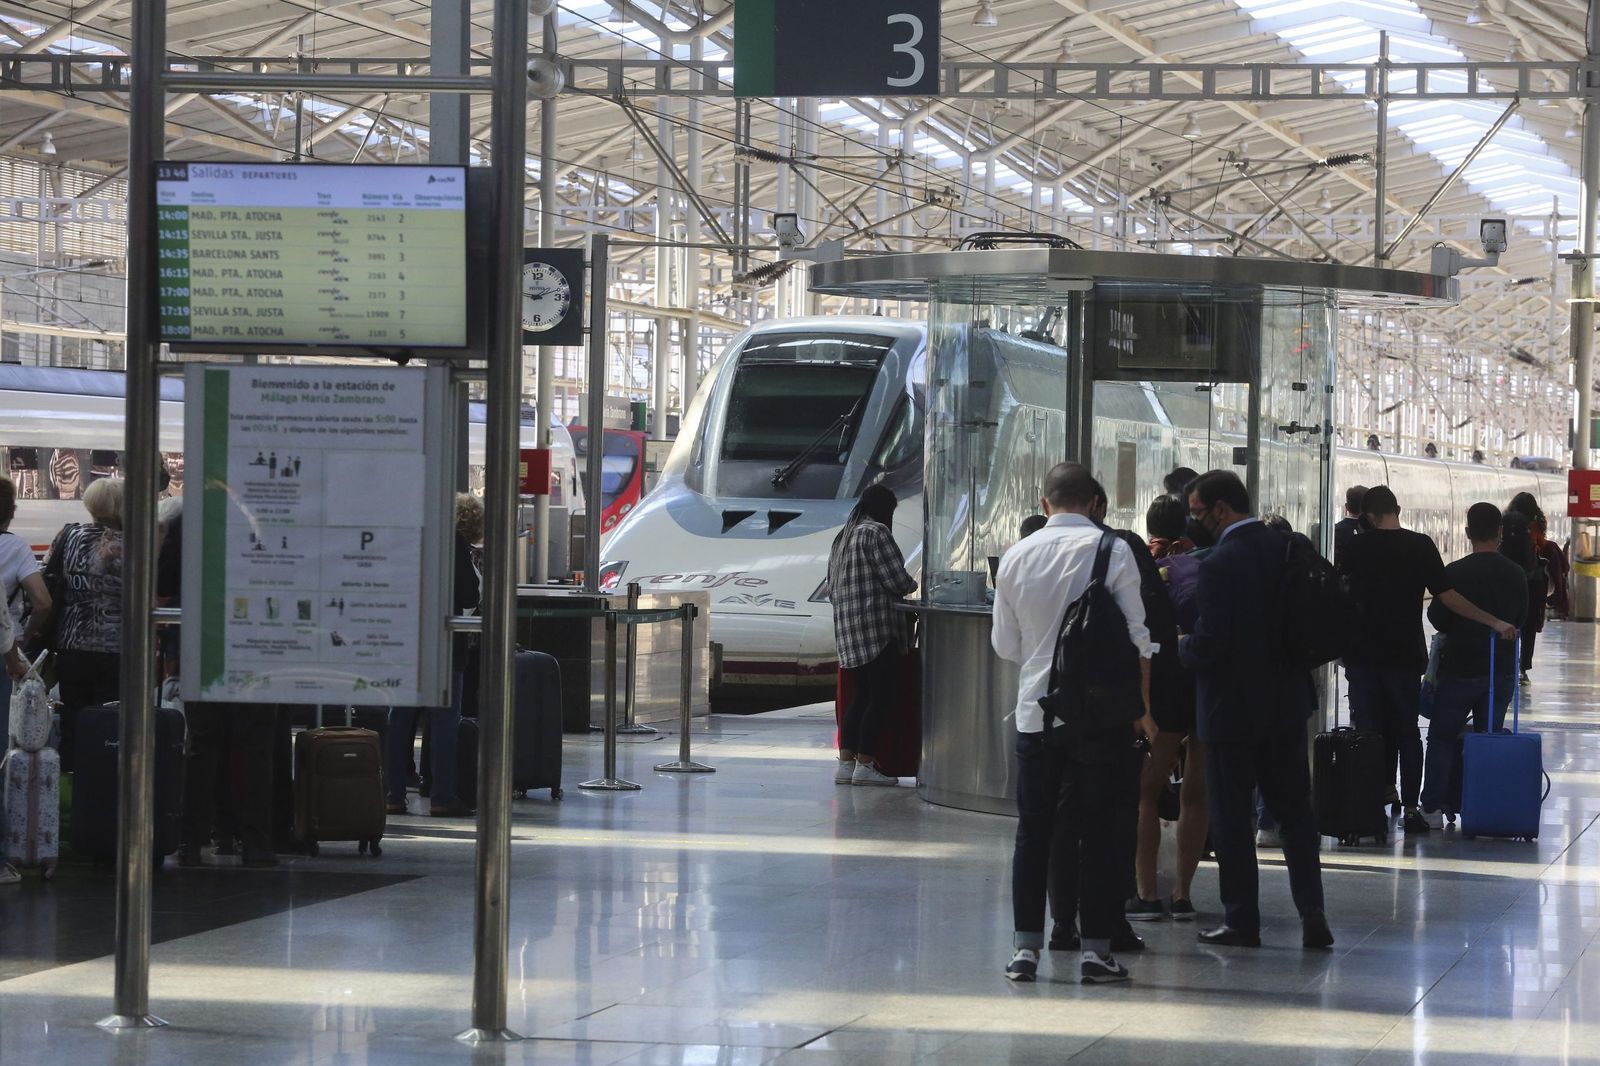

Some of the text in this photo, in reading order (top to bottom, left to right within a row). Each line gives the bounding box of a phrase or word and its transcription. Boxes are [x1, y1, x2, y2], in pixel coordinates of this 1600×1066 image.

[887, 13, 925, 87] 3
[190, 166, 298, 180] Salidas DEPARTURES
[160, 211, 188, 220] 14:00
[191, 211, 217, 220] MAD.
[220, 211, 242, 220] PTA.
[245, 211, 282, 221] ATOCHA
[398, 213, 405, 223] 2
[160, 230, 188, 240] 14:15
[191, 230, 228, 240] SEVILLA
[231, 230, 251, 241] STA.
[255, 231, 283, 241] JUSTA
[398, 233, 404, 243] 1
[160, 249, 189, 258] 14:35
[192, 249, 247, 259] BARCELONA
[250, 250, 279, 259] SANTS
[399, 252, 405, 262] 3
[160, 268, 189, 278] 16:15
[192, 268, 218, 278] MAD.
[221, 269, 243, 279] PTA.
[246, 269, 283, 279] ATOCHA
[398, 271, 405, 280] 4
[532, 272, 543, 280] 12
[160, 287, 190, 297] 17:00
[193, 288, 218, 297] MAD.
[222, 288, 243, 298] PTA.
[246, 288, 284, 298] ATOCHA
[399, 291, 405, 300] 3
[160, 306, 190, 316] 17:19
[193, 306, 229, 316] SEVILLA
[232, 307, 252, 317] STA.
[256, 308, 284, 317] JUSTA
[399, 310, 406, 319] 7
[533, 314, 541, 322] 6
[160, 325, 190, 335] 18:00
[193, 326, 219, 336] MAD.
[222, 326, 245, 336] PTA.
[247, 326, 284, 336] ATOCHA
[399, 329, 406, 339] 5
[251, 379, 396, 391] Bienvenido a la estación de
[261, 392, 386, 404] Málaga María Zambrano
[375, 415, 396, 424] 5:00
[361, 531, 374, 551] P
[625, 571, 768, 588] renfe
[719, 593, 796, 609] AVE
[370, 677, 402, 689] adif
